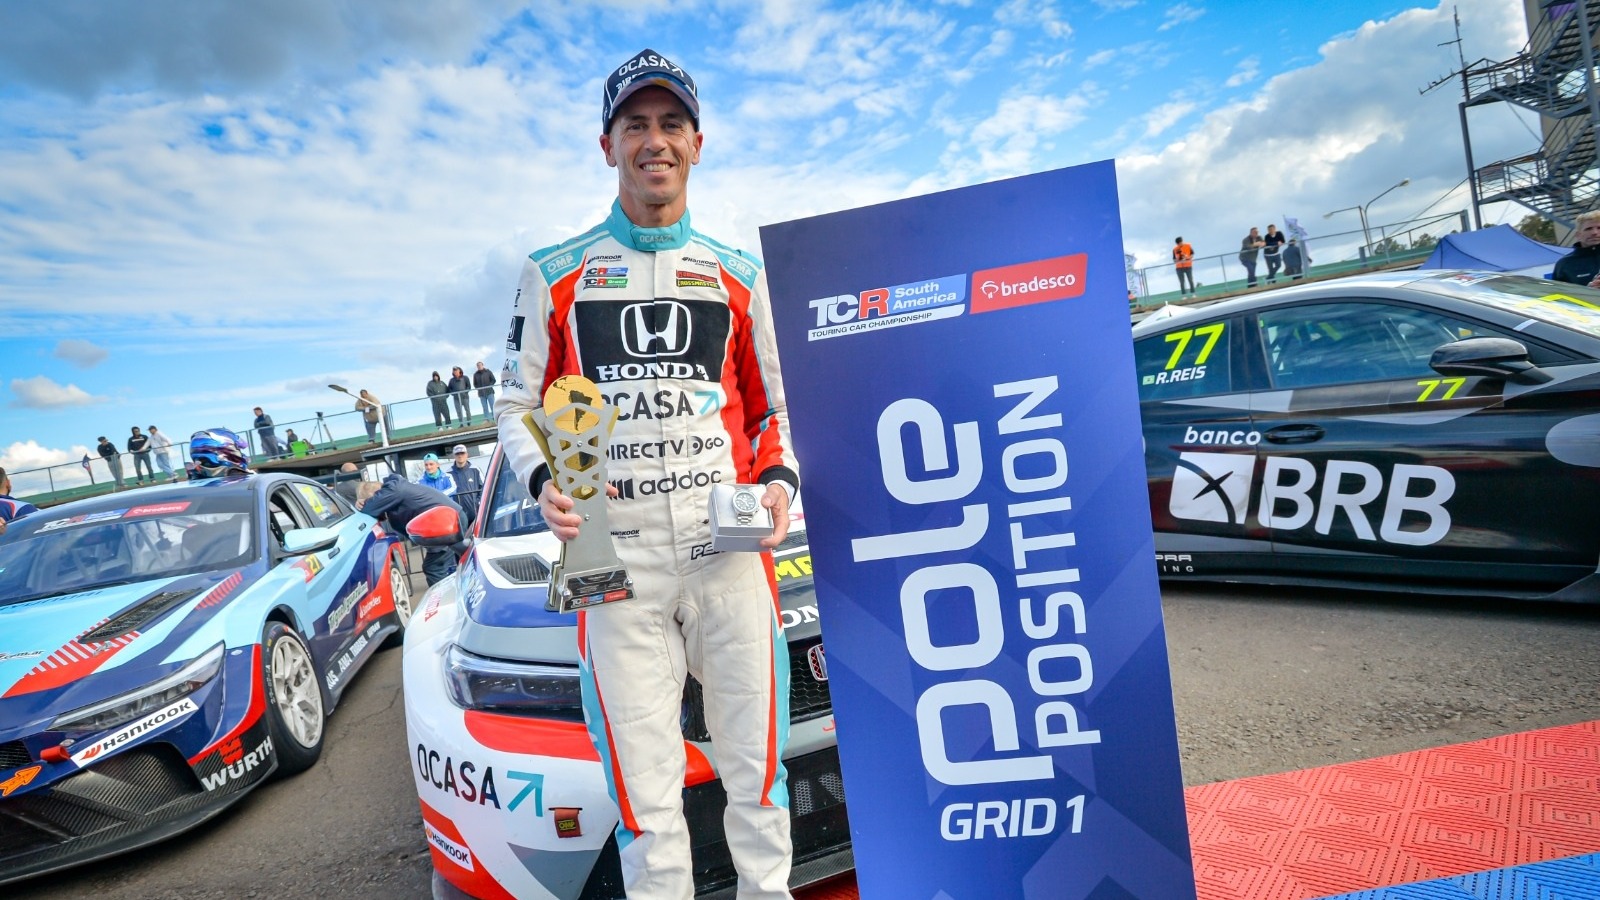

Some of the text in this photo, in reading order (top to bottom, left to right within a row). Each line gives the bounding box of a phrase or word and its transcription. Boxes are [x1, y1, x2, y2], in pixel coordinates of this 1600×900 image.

[618, 55, 670, 76] OCASA
[547, 254, 574, 273] OMP
[894, 281, 940, 299] South
[1001, 273, 1076, 297] bradesco
[808, 288, 890, 328] TCR
[892, 291, 957, 311] America
[811, 312, 933, 339] TOURING CAR CHAMPIONSHIP
[1165, 323, 1225, 370] 77
[596, 361, 710, 381] HONDA
[1155, 365, 1207, 385] R.REIS
[1416, 377, 1466, 402] 77
[1183, 426, 1262, 446] banco
[606, 439, 685, 460] IRECTV
[638, 470, 722, 495] addoc
[1257, 455, 1456, 546] BRB
[993, 375, 1102, 748] POSITION
[851, 397, 1056, 787] pole
[417, 743, 501, 810] OCASA
[558, 821, 576, 830] OMP
[940, 794, 1086, 841] GRID 1
